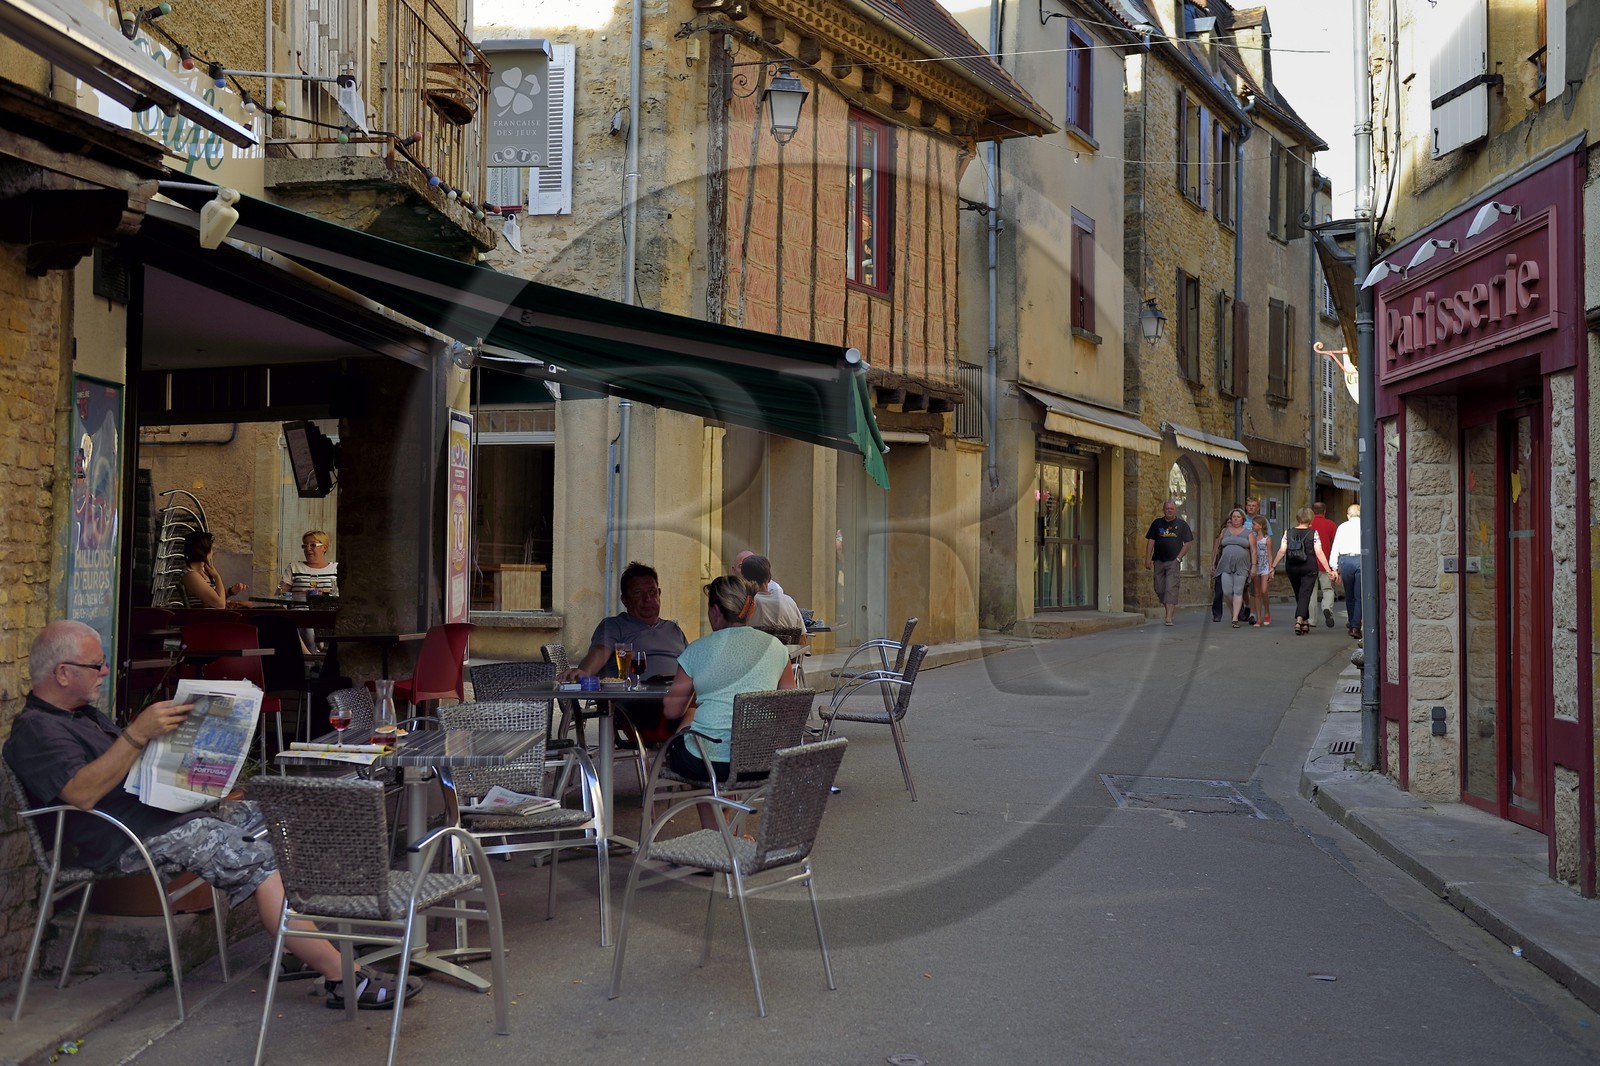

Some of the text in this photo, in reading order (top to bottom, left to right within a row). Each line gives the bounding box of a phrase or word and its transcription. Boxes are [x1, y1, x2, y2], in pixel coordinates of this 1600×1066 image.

[516, 129, 537, 137] JEUX
[492, 146, 541, 164] LOTO
[1386, 253, 1541, 362] Patisserie
[453, 512, 464, 551] 10
[75, 549, 110, 569] MILLIONS
[73, 571, 110, 590] D'EUROS
[193, 766, 228, 777] PORTUGAL
